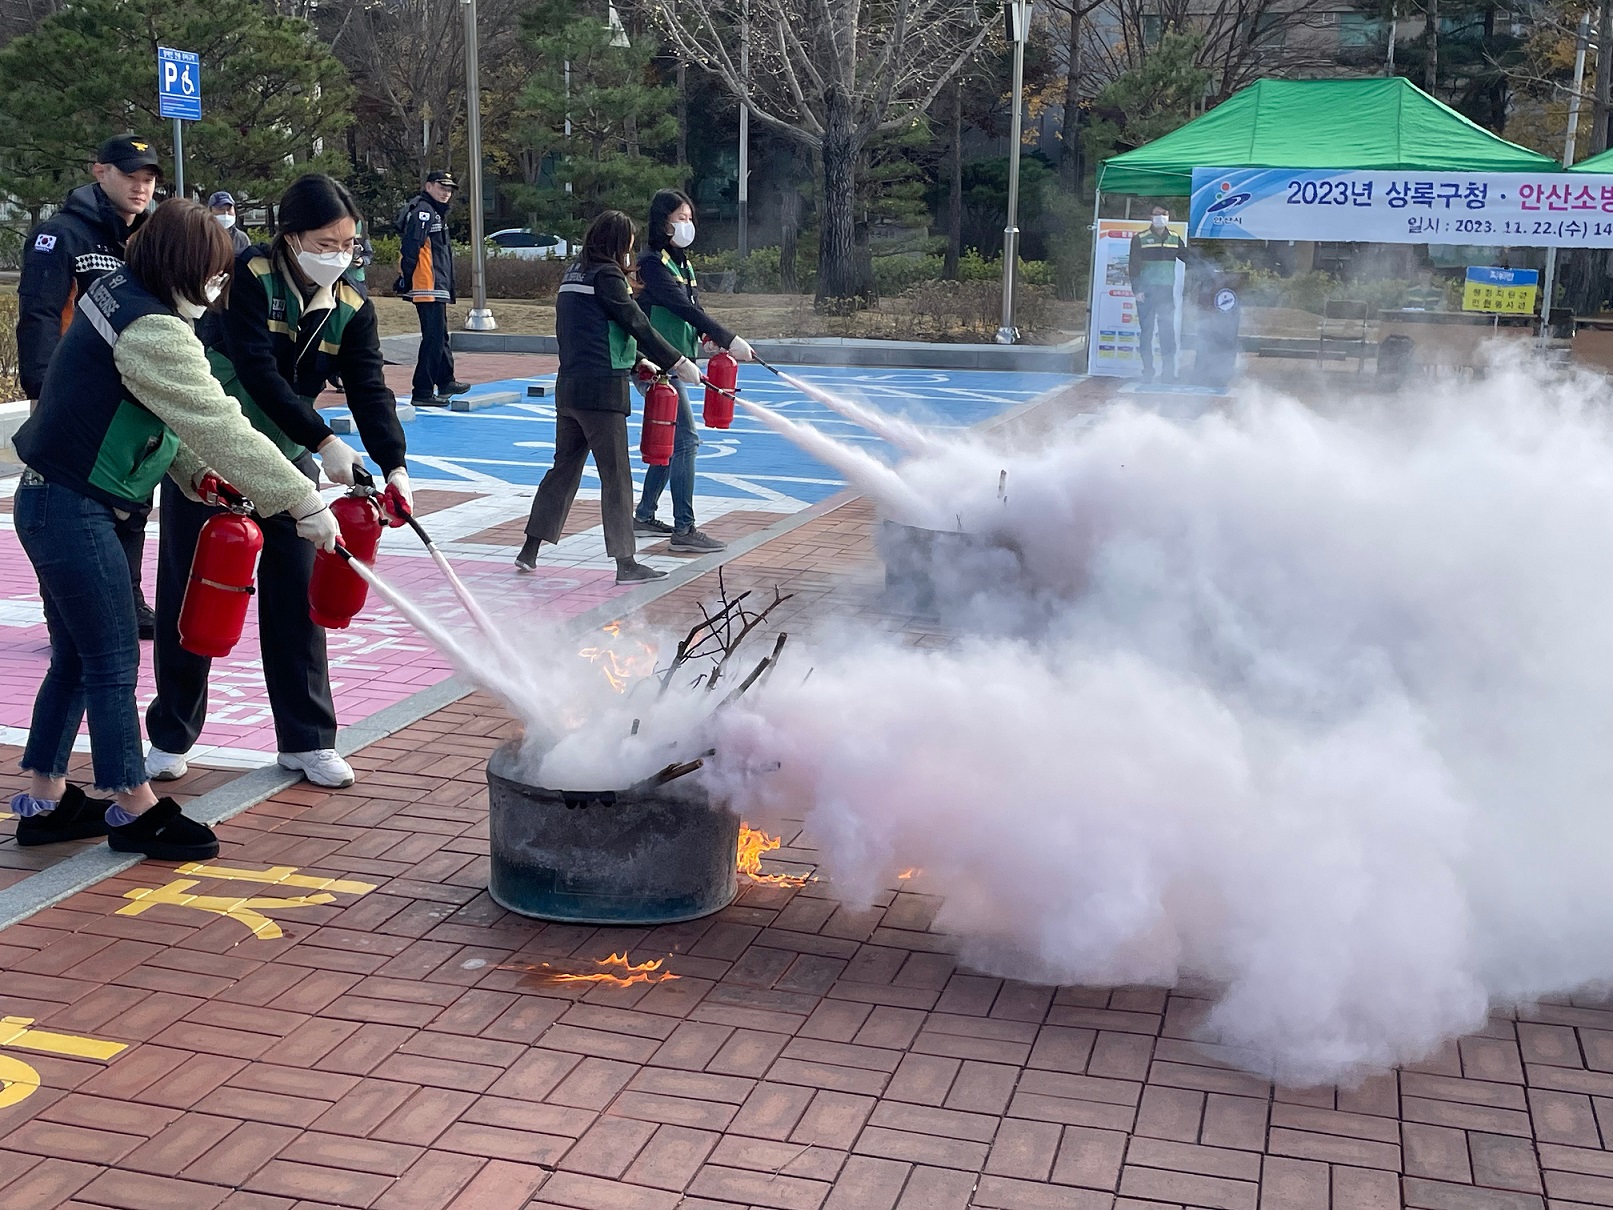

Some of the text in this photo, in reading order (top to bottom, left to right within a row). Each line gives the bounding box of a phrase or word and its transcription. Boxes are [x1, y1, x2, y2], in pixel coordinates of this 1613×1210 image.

[164, 61, 178, 92] P
[1286, 180, 1373, 208] 2023년
[1385, 181, 1488, 210] 상록구청
[1213, 216, 1242, 225] 안산시
[1407, 216, 1440, 234] 일시
[1455, 219, 1496, 233] 2023.
